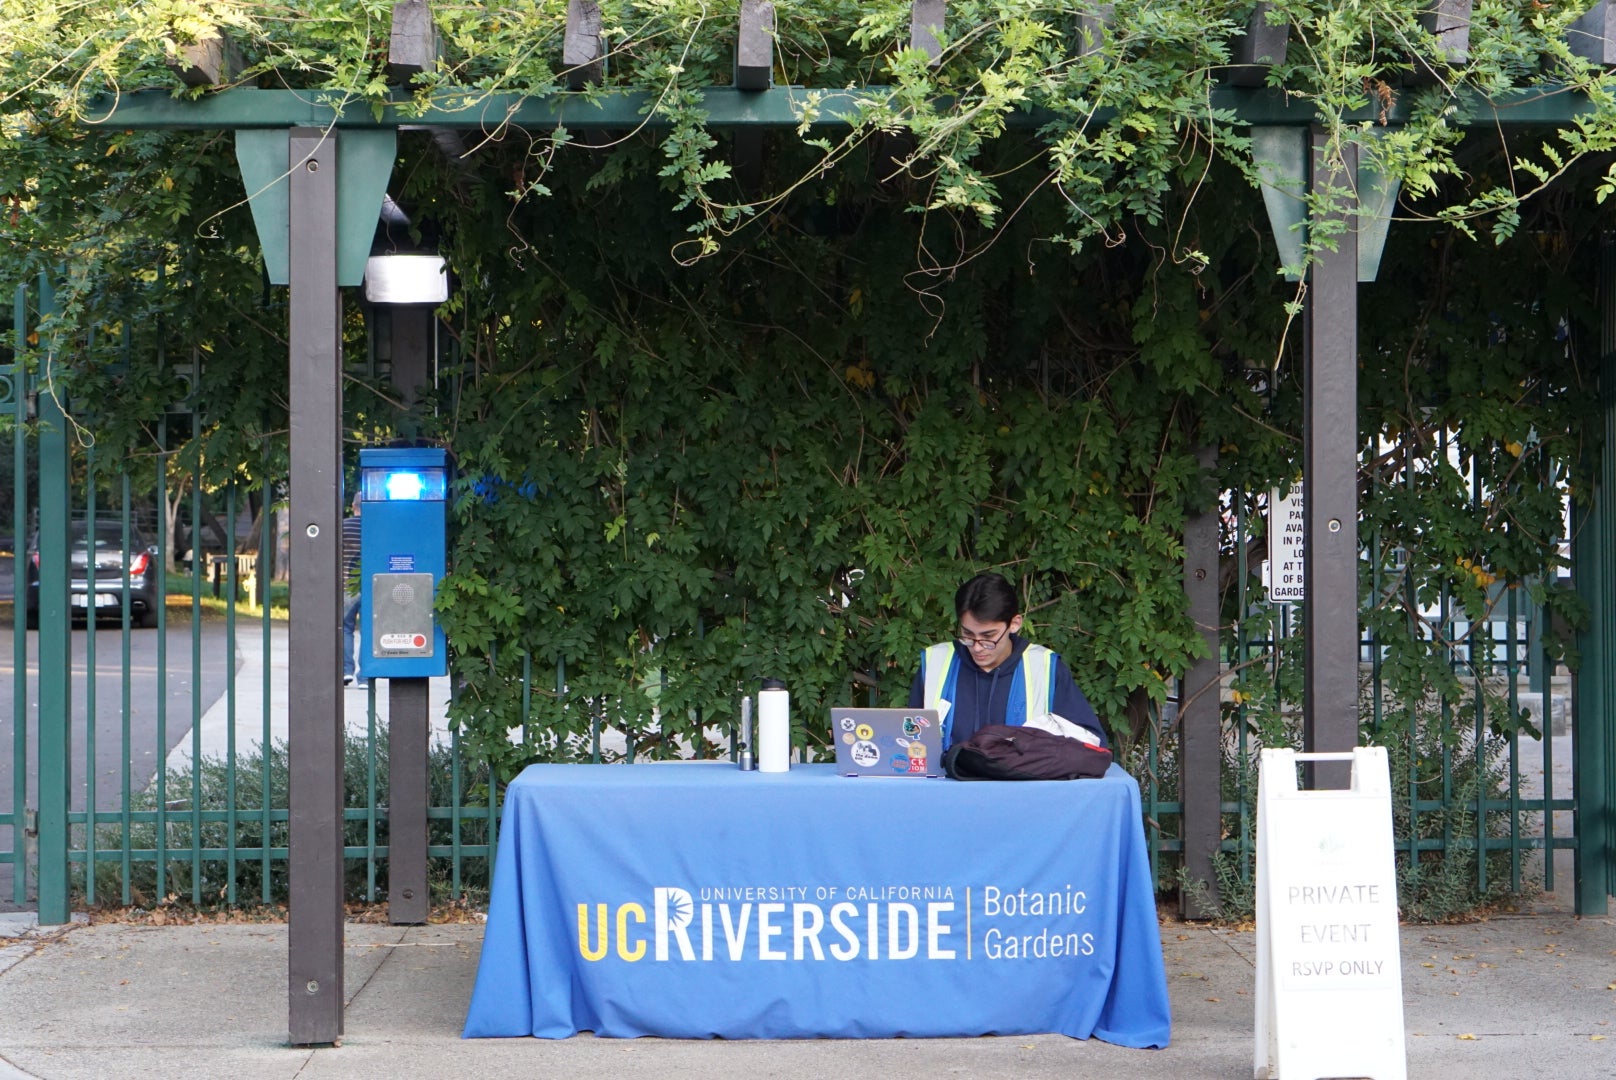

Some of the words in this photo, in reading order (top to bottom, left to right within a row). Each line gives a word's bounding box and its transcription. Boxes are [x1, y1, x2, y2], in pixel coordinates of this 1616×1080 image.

[1285, 523, 1303, 532] AVA
[1283, 536, 1292, 545] IN
[1283, 561, 1294, 570] AT
[1283, 574, 1293, 583] OF
[1274, 587, 1304, 596] GARDE
[701, 887, 808, 900] UNIVERSITY
[816, 887, 837, 900] OF
[846, 886, 954, 900] CALIFORNIA
[1288, 885, 1380, 904] PRIVATE
[984, 884, 1087, 917] Botanic
[1301, 923, 1372, 943] EVENT
[984, 928, 1095, 960] Gardens
[1292, 961, 1334, 976] RSVP
[1339, 960, 1384, 976] ONLY
